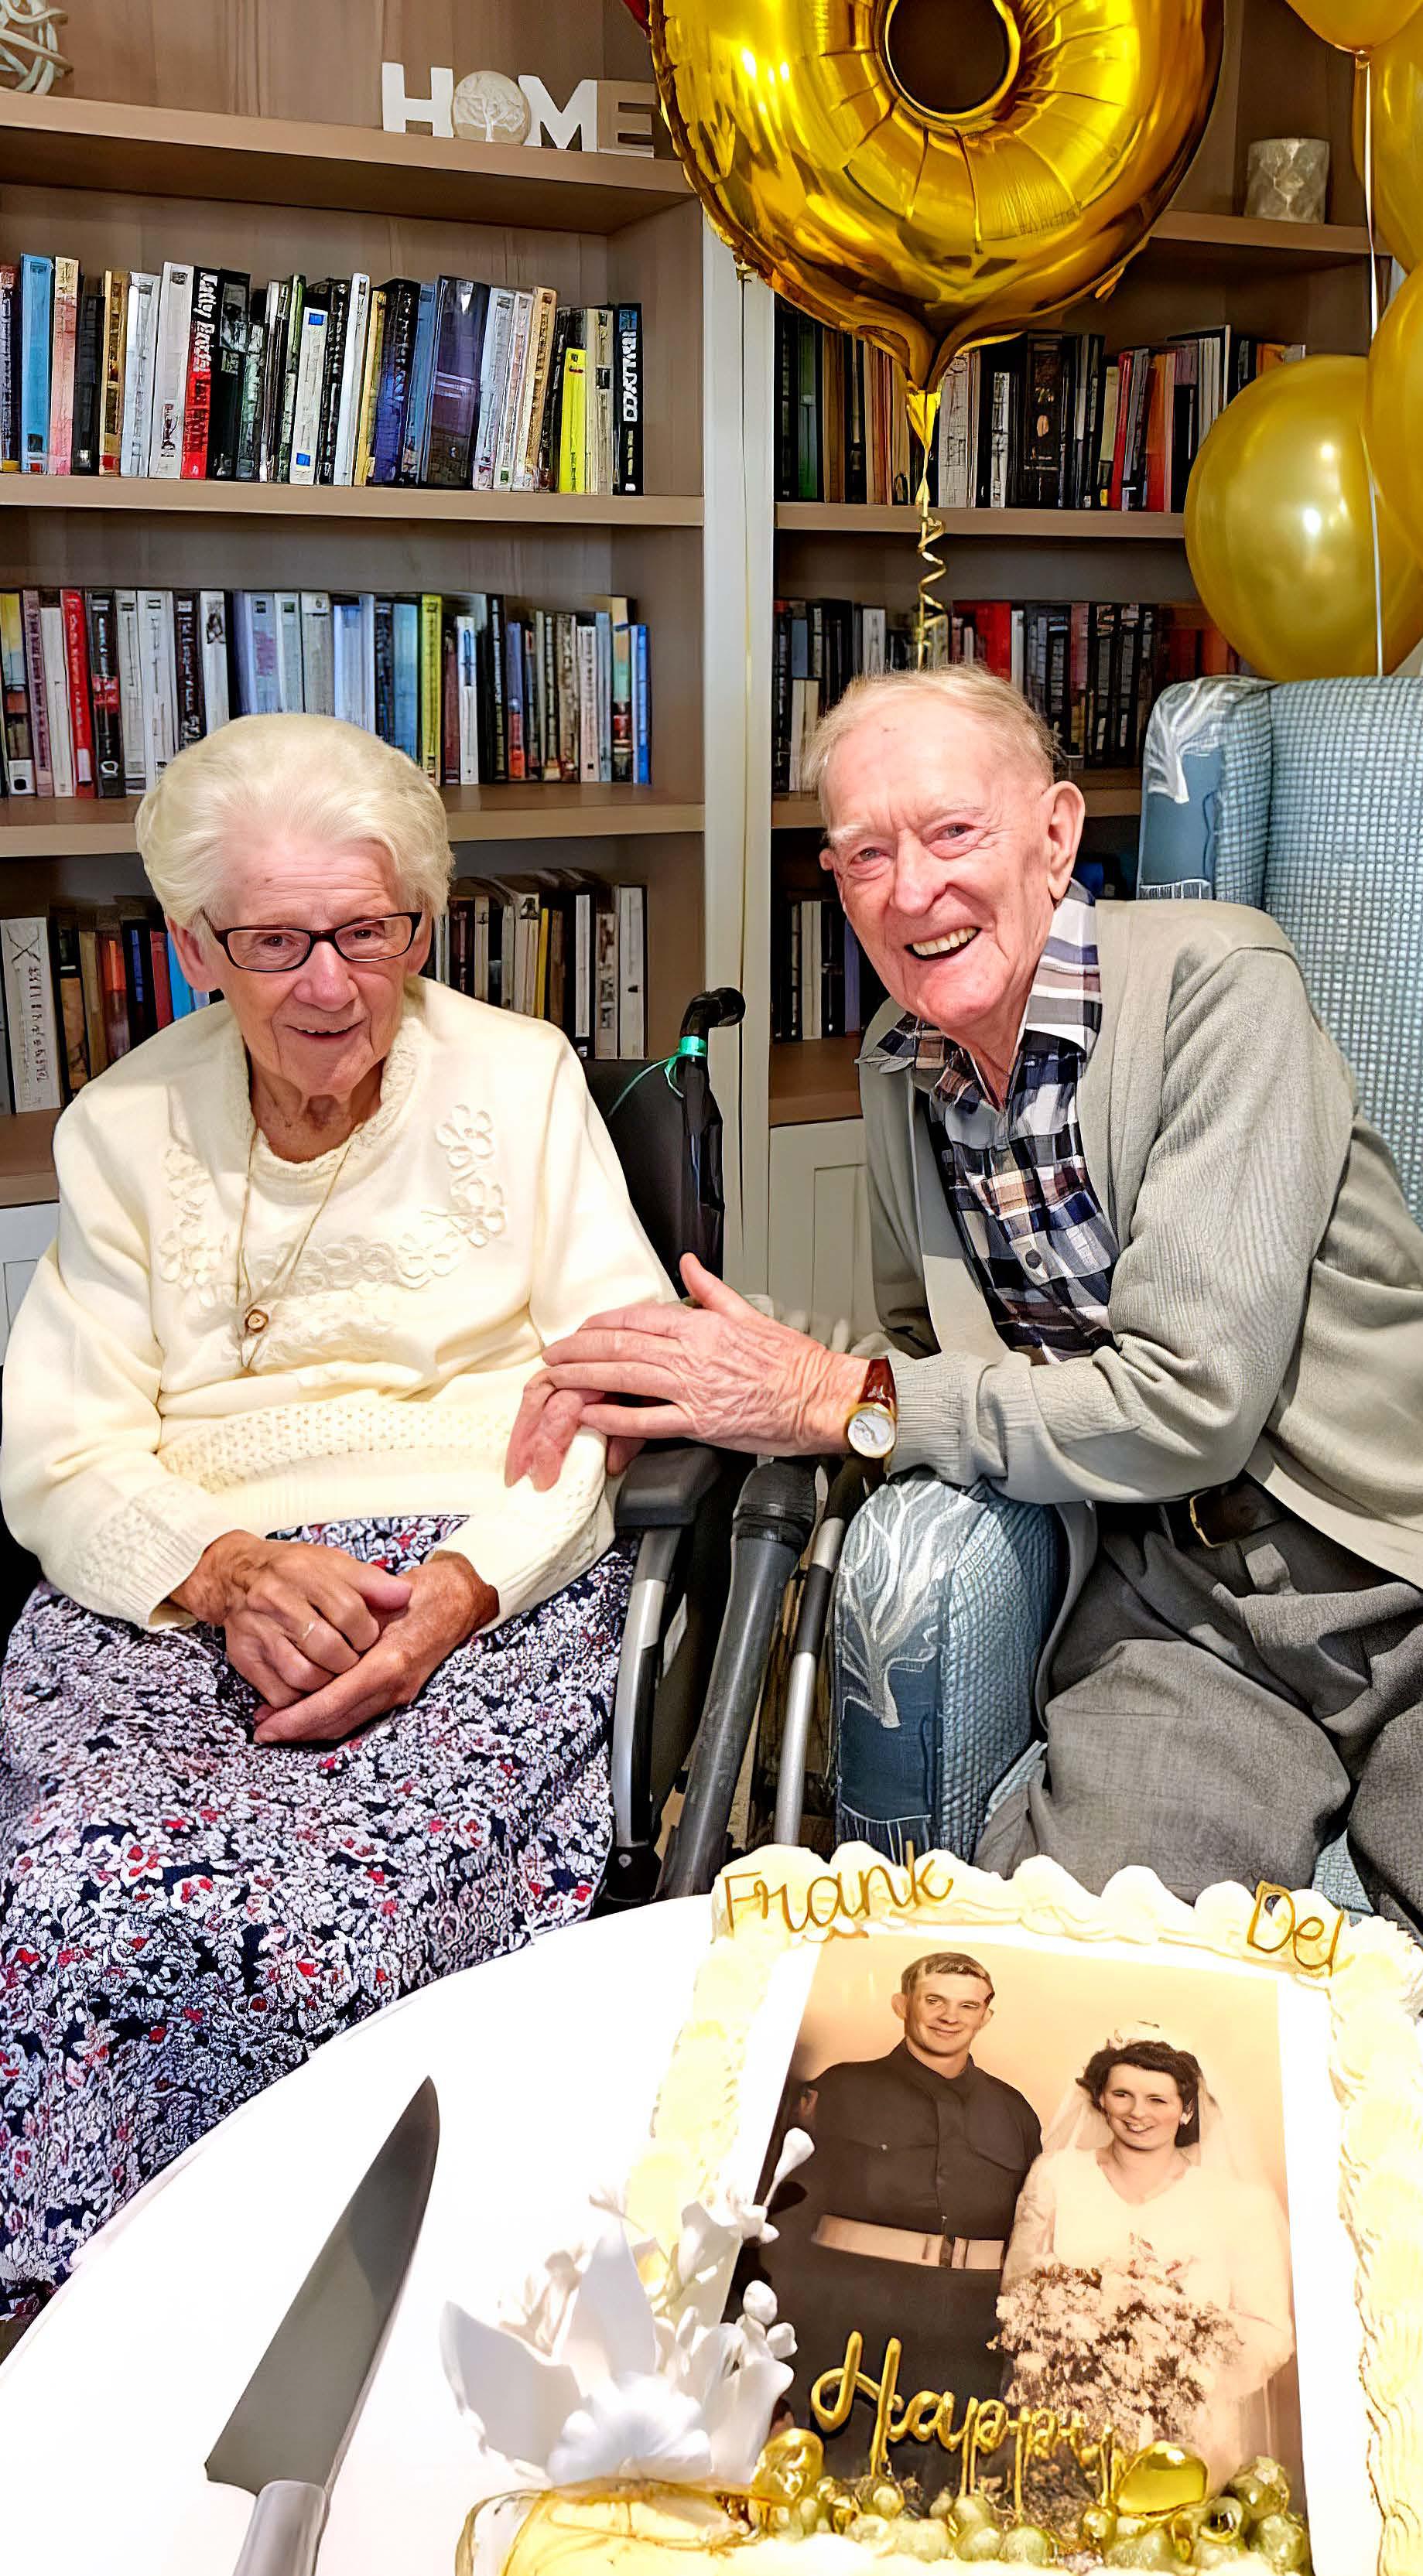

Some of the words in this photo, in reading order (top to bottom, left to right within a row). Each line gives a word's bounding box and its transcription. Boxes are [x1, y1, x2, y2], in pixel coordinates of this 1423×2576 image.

[381, 62, 655, 159] HOME
[724, 1840, 954, 1932] Frank
[1247, 1880, 1345, 1978] Del
